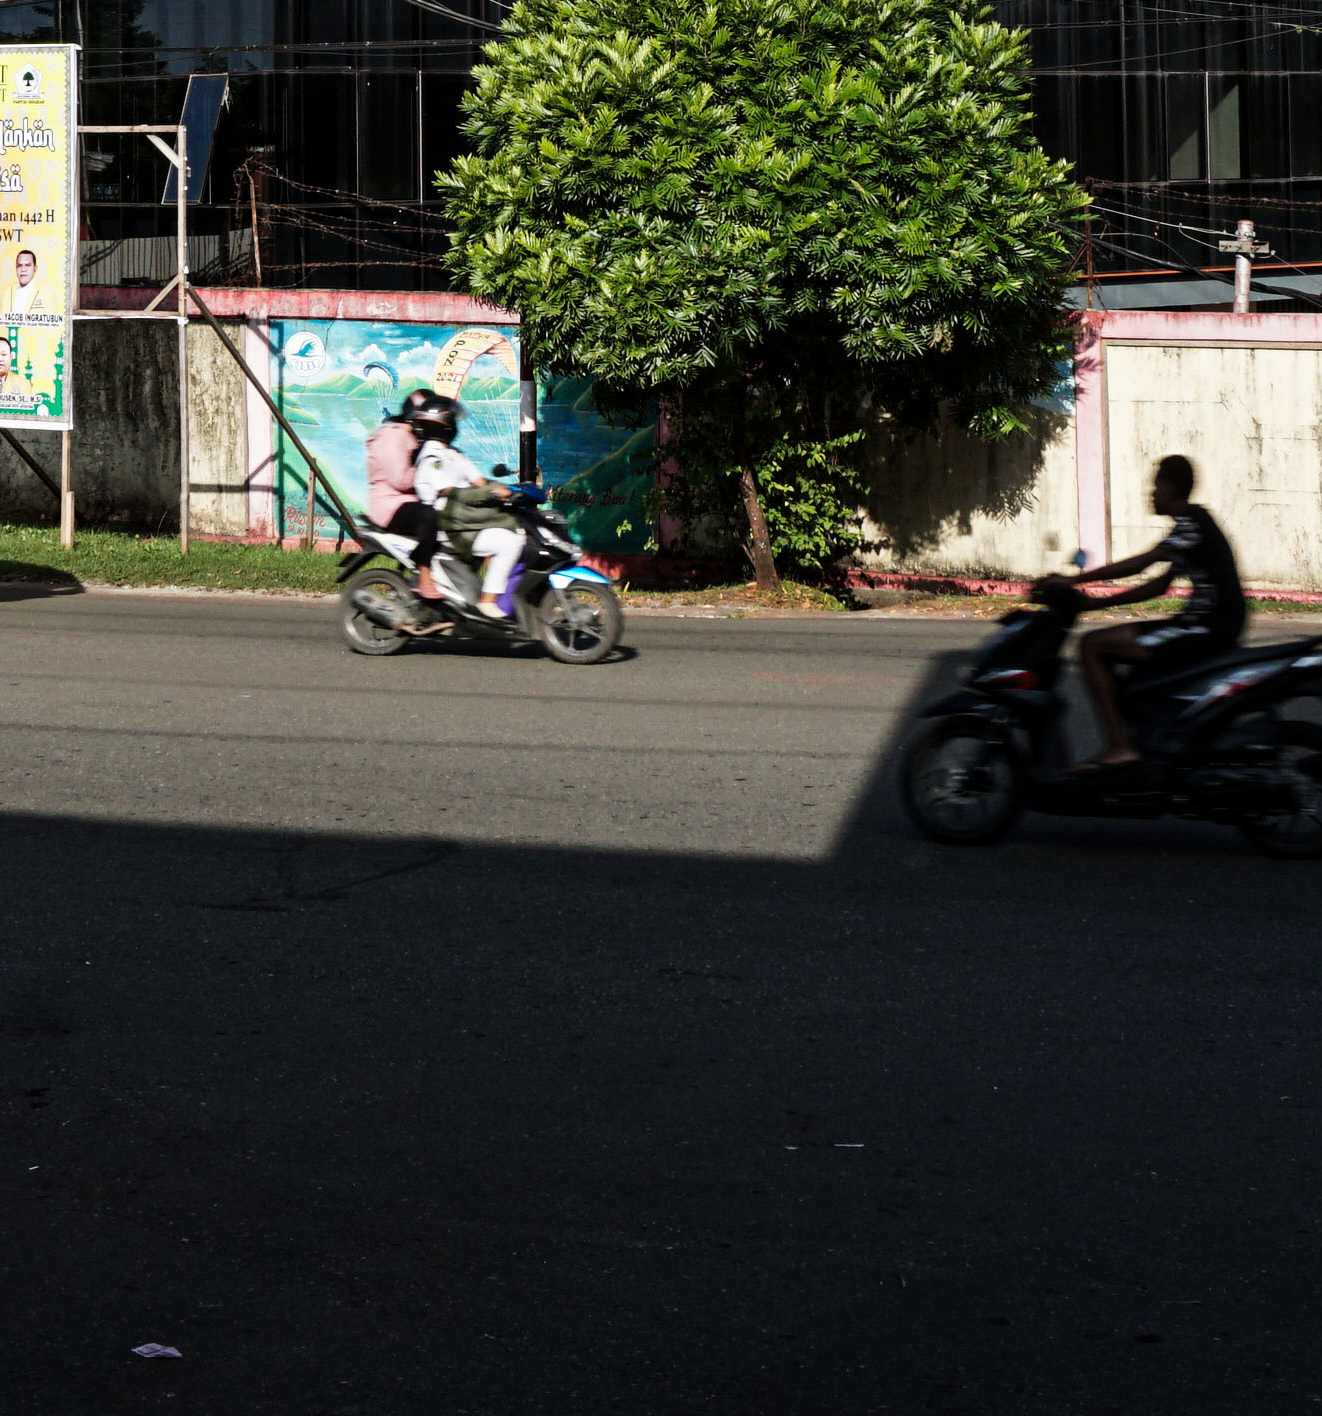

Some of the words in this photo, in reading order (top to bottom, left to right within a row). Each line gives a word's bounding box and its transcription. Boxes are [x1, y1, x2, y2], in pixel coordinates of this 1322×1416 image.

[19, 212, 42, 224] 1442
[46, 209, 55, 222] H
[4, 313, 24, 322] YACOB
[25, 314, 64, 323] INGRATUBUN
